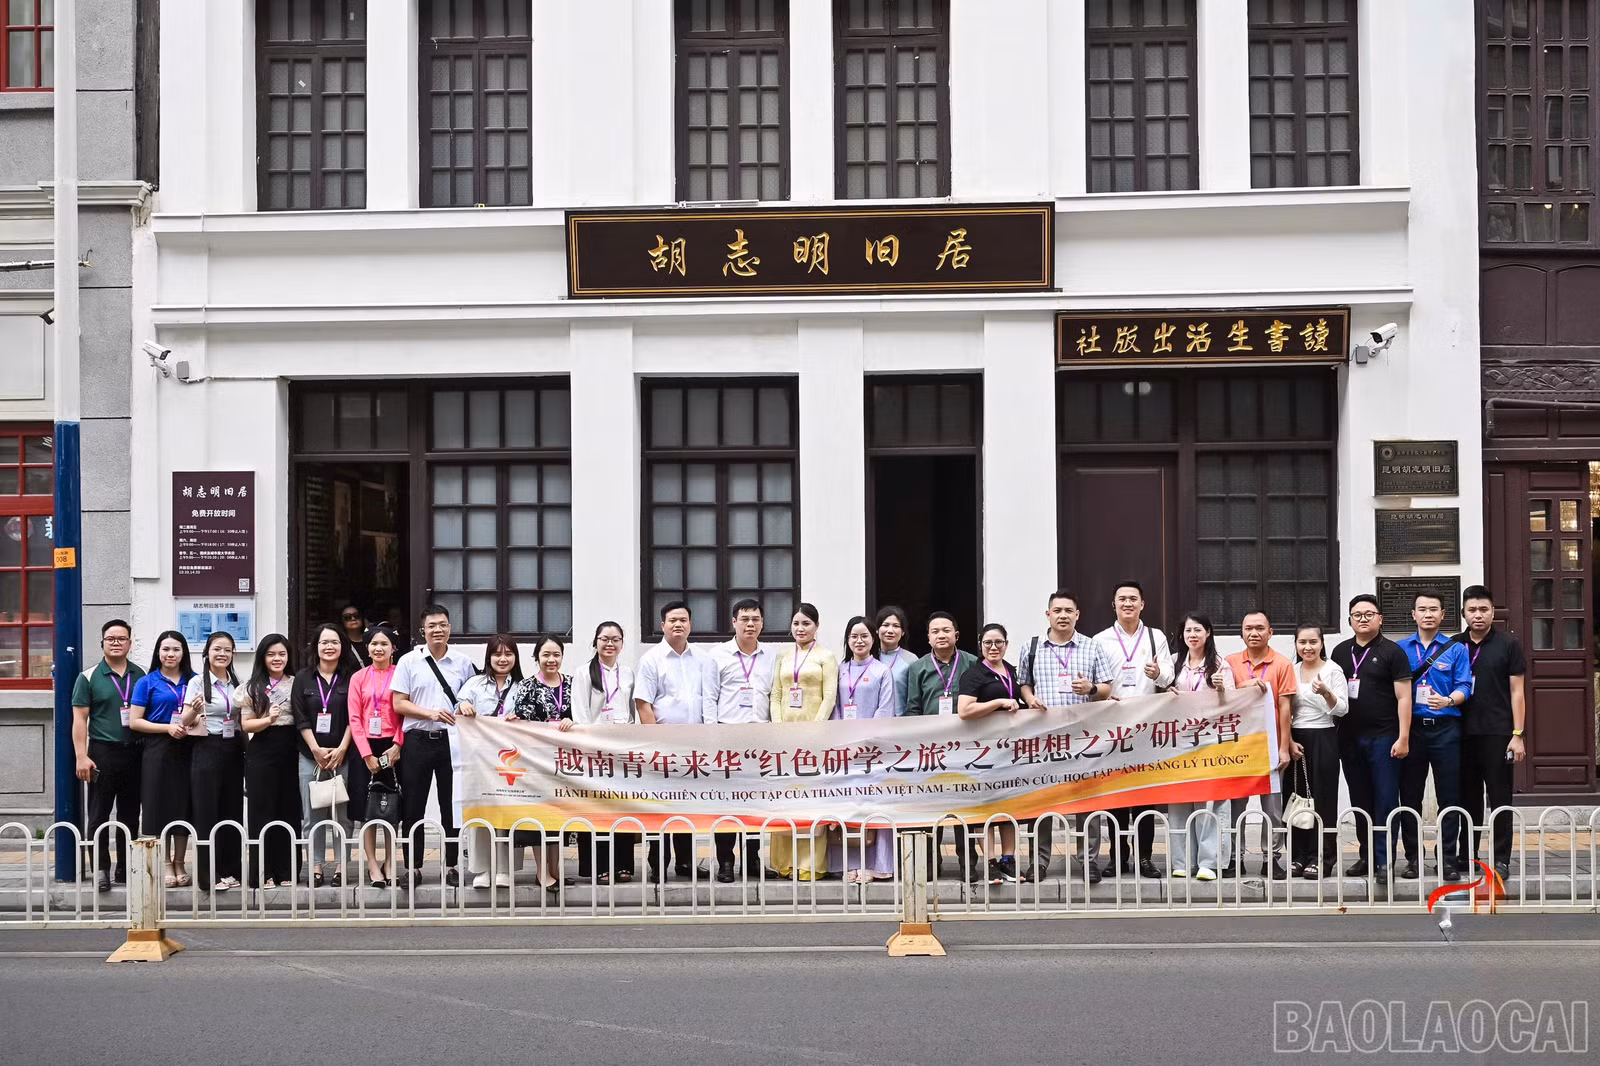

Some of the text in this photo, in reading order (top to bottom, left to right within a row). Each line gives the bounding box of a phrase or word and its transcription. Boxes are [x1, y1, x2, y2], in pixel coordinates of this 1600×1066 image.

[647, 228, 973, 276] 胡志明旧居
[1381, 464, 1451, 474] 昆明胡志明旧居
[182, 485, 248, 498] 胡志明旧居
[191, 509, 236, 518] 免费开放时间
[554, 786, 588, 798] HÀNH
[591, 787, 629, 800] TRÌNH
[631, 788, 649, 800] ĐỎ
[651, 788, 698, 801] NGHIÊN
[700, 788, 729, 802] CỨU,
[731, 790, 757, 802] HỌC
[784, 787, 810, 799] CỦA
[811, 788, 852, 799] THANH
[855, 784, 883, 796] NIÊN
[886, 783, 914, 797] VIỆT
[917, 784, 944, 794] NAM
[953, 782, 981, 794] TRẠI
[984, 776, 1029, 791] NGHIÊN
[1032, 773, 1061, 786] CỨU,
[1064, 772, 1090, 784] HỌC
[1148, 760, 1180, 772] SÁNG
[1183, 757, 1199, 769] LÝ
